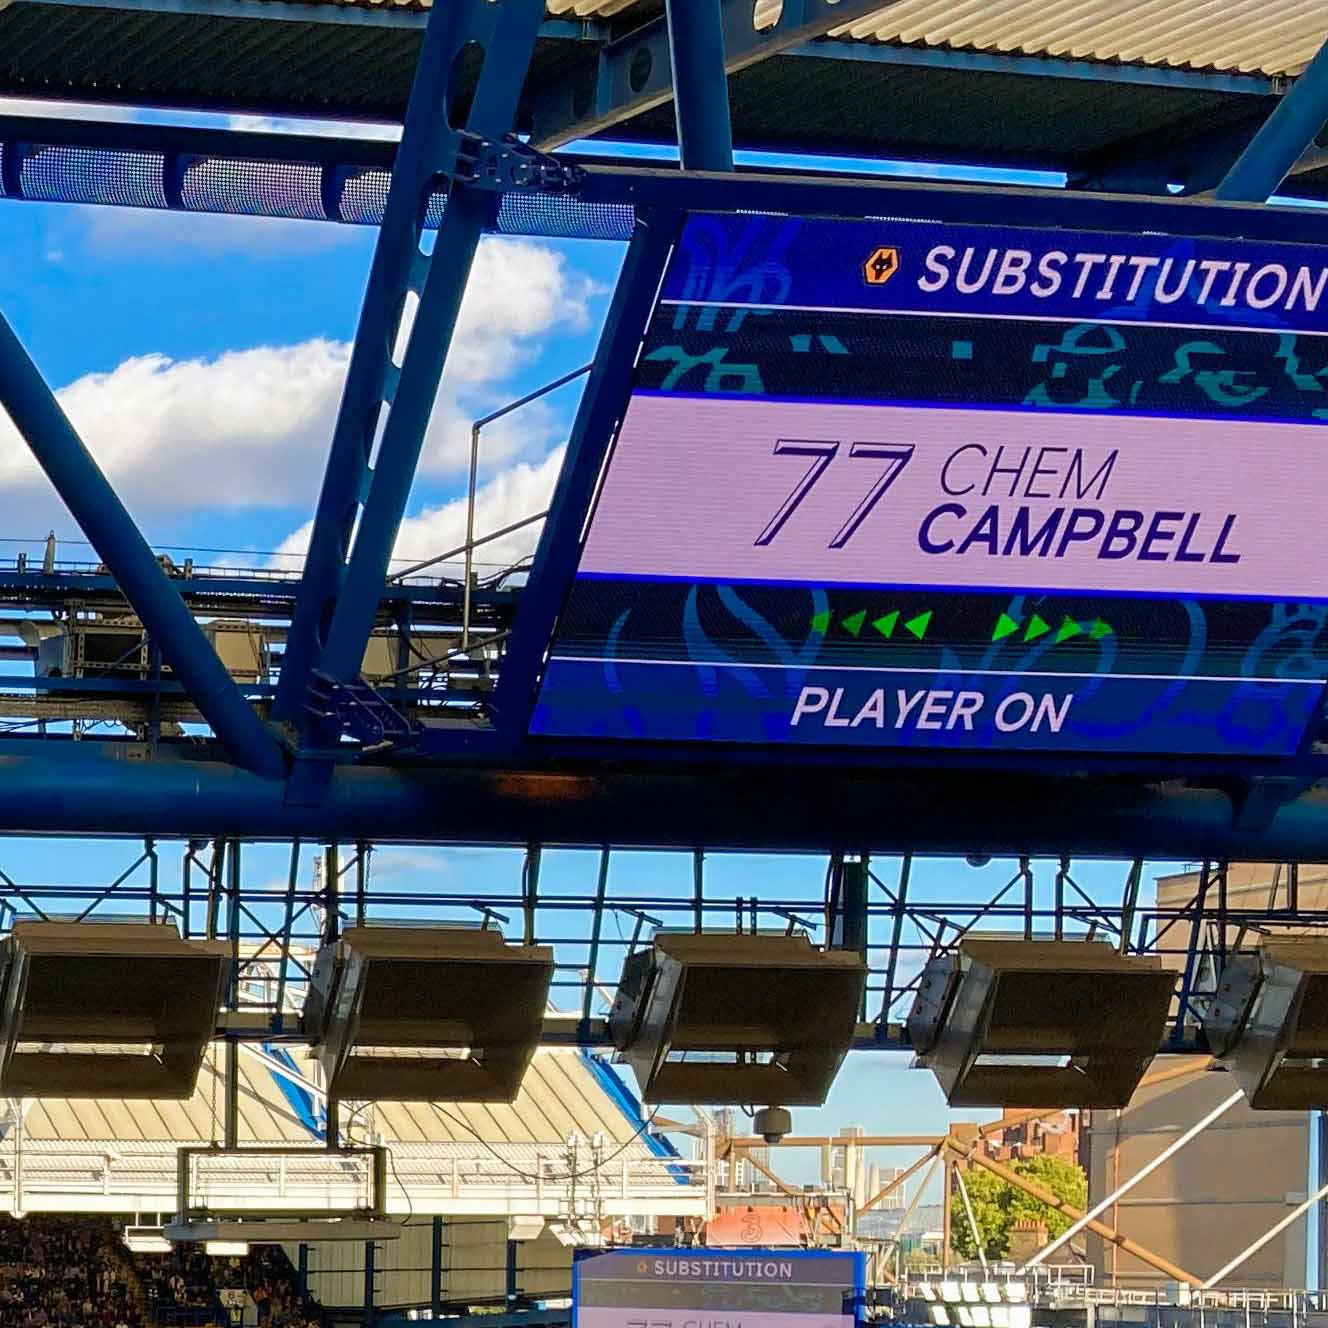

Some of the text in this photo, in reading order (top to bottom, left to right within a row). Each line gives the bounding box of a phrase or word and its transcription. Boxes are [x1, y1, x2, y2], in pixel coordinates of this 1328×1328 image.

[918, 245, 1328, 313] SUBSTITUTION
[755, 437, 916, 549] 77
[939, 443, 1120, 502] CHEM
[917, 503, 1244, 565] CAMPBELL
[790, 686, 1075, 735] PLAYER ON
[654, 1260, 793, 1279] SUBSTITUTION
